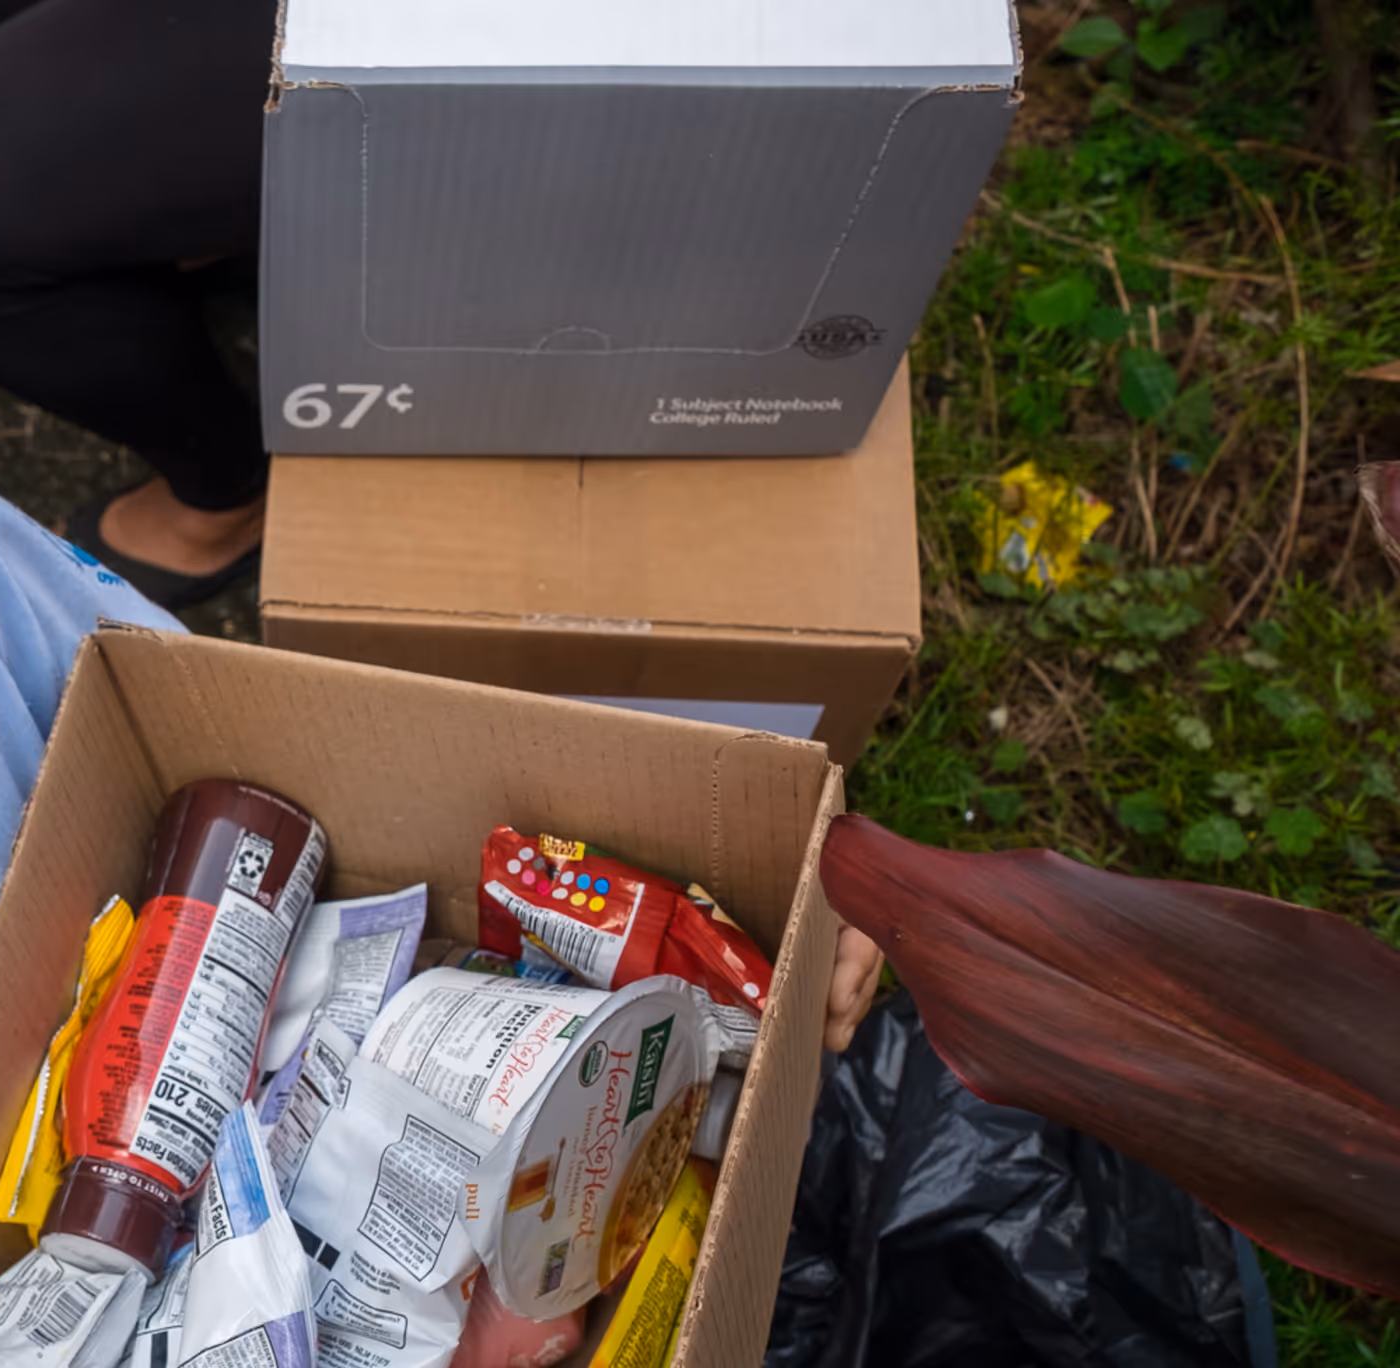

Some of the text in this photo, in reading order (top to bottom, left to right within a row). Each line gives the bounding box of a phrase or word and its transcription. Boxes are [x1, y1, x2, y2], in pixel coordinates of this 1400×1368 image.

[282, 382, 414, 429] 67¢
[650, 412, 781, 427] College Ruled
[671, 398, 744, 412] Subject
[746, 398, 842, 411] Notebook
[485, 1004, 542, 1069] Nutrition
[494, 1002, 531, 1040] Facts
[526, 1005, 573, 1043] Heart
[488, 1055, 528, 1106] Heart
[635, 1030, 665, 1106] Kashi
[154, 1077, 189, 1107] 210
[135, 1134, 166, 1160] Facts
[572, 1051, 633, 1253] Heart to Heart
[99, 1166, 168, 1202] TWIST TO OPEN
[465, 1184, 479, 1218] pull
[210, 1203, 226, 1240] Facts
